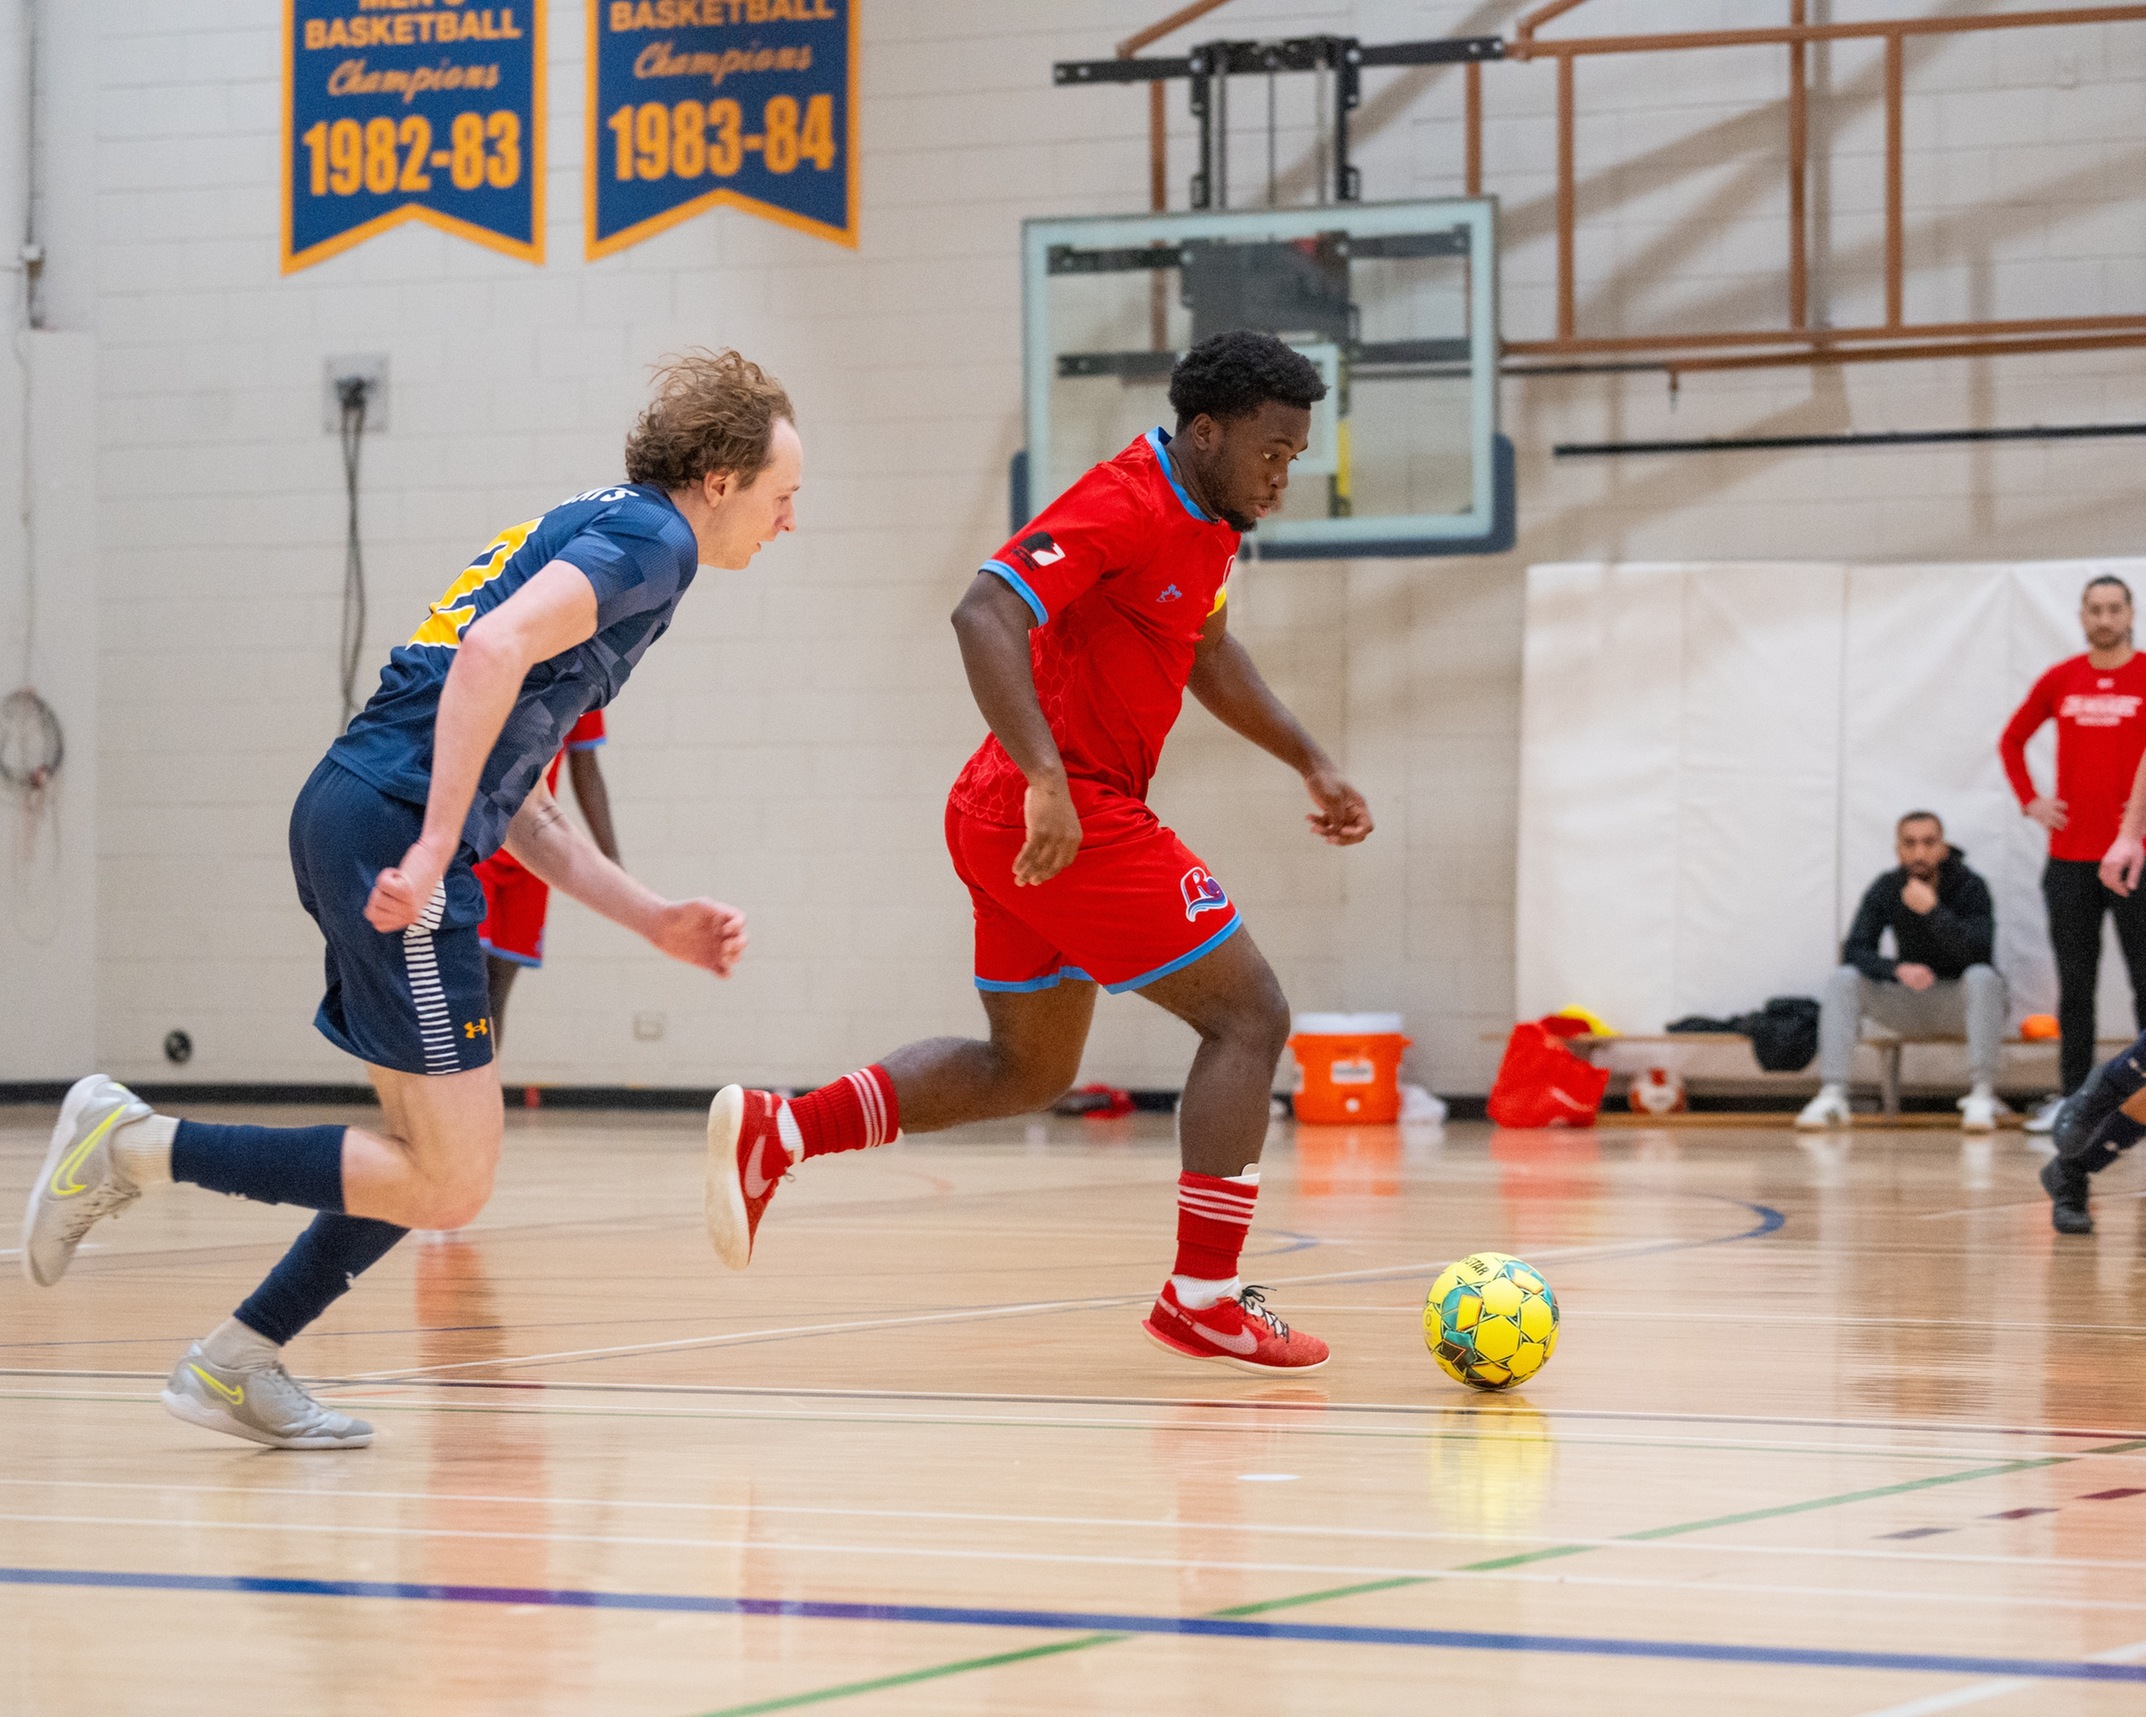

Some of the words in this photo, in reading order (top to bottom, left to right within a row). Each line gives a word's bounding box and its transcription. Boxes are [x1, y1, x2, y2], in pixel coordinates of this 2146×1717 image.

[304, 9, 522, 49] BASKETBALL
[609, 0, 836, 32] BASKETBALL
[327, 57, 499, 104] Champions
[633, 39, 812, 87] Champions
[303, 110, 520, 196] 1982-83
[608, 94, 835, 181] 1983-84
